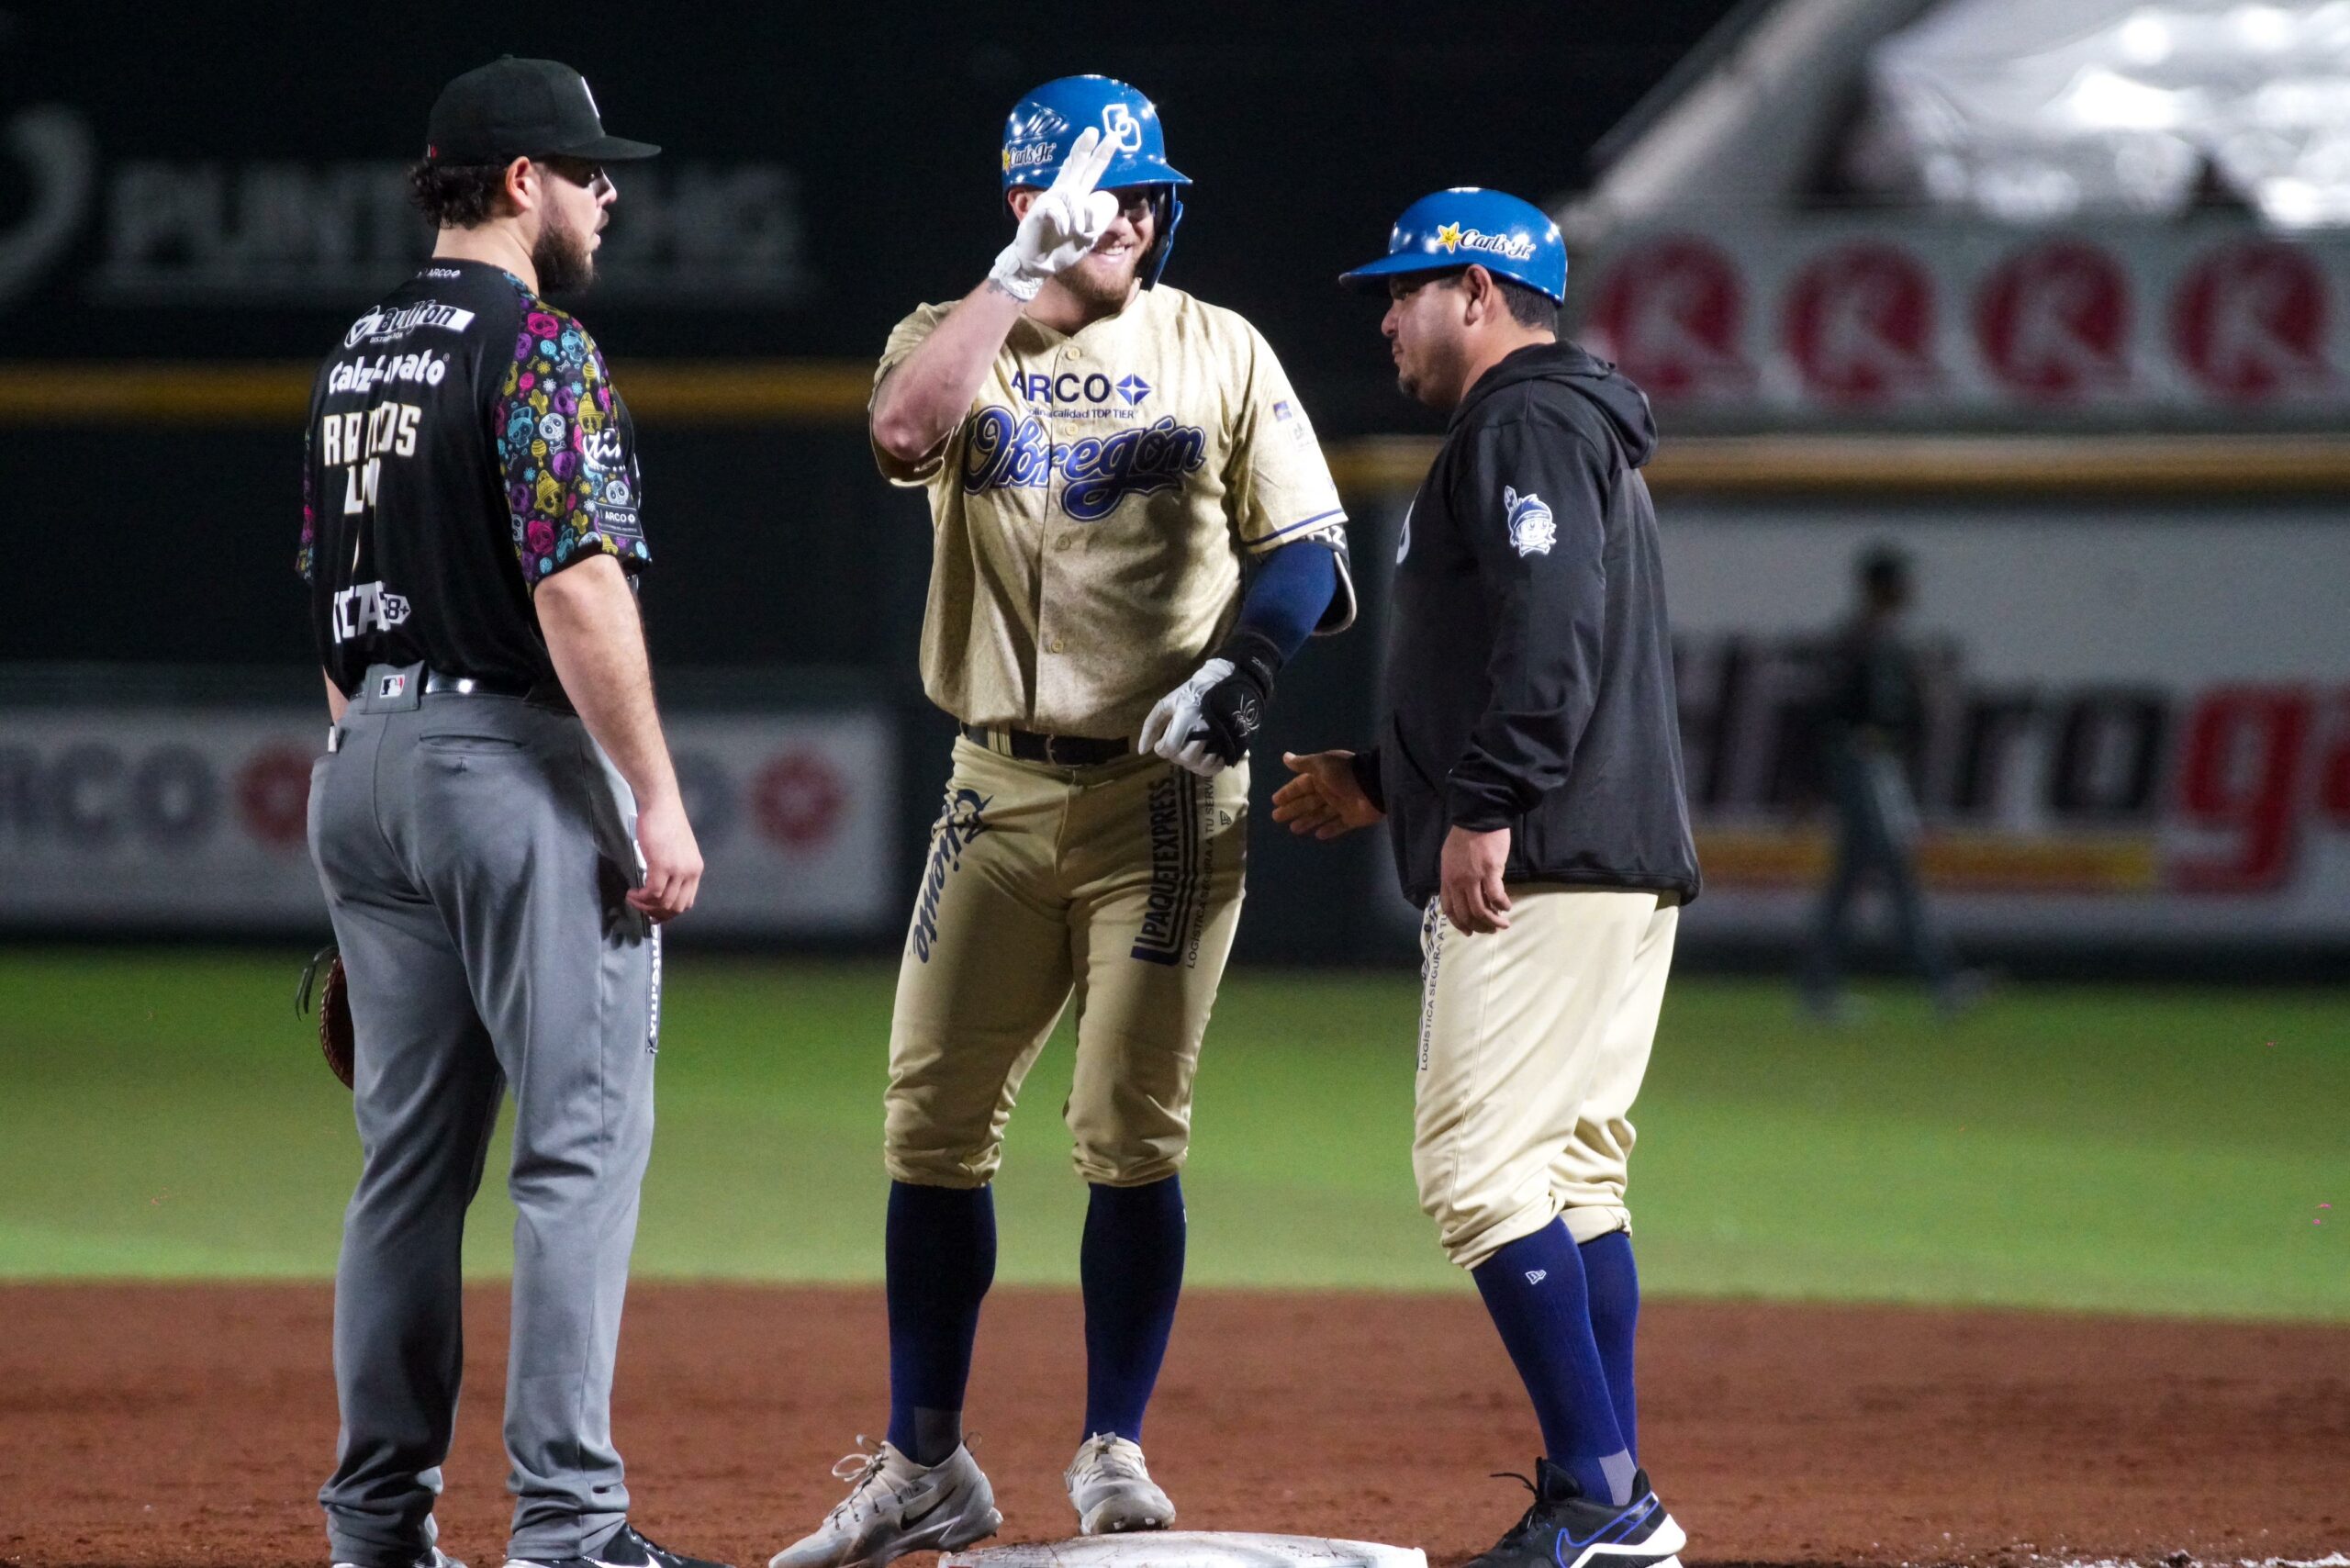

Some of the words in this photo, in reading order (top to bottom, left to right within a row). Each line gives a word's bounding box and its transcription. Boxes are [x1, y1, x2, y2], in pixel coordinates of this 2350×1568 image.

[1460, 229, 1506, 252] Carl's
[1011, 371, 1112, 404] ARCO
[1054, 408, 1090, 420] calidad
[1091, 409, 1112, 420] TOP
[1113, 409, 1135, 420] TIER
[963, 406, 1206, 522] Obregón
[605, 510, 627, 522] ARCO
[1205, 818, 1214, 834] TU
[1430, 944, 1442, 996] SEGURA
[1437, 932, 1445, 941] A
